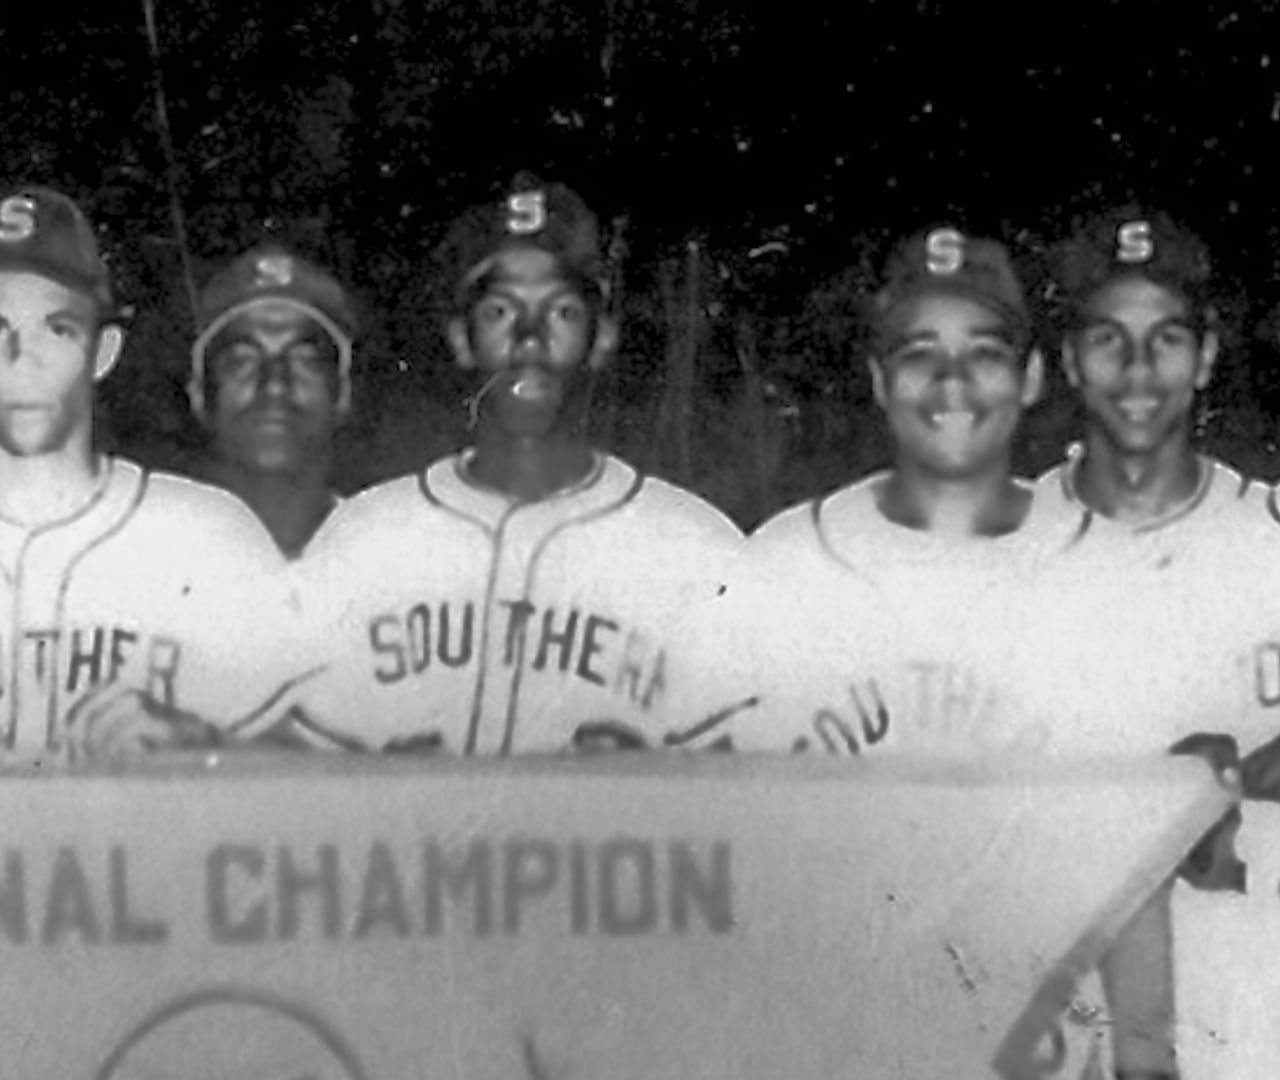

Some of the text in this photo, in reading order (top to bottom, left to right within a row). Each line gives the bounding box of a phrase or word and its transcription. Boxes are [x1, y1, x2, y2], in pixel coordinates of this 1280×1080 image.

[507, 190, 545, 233] S
[926, 227, 965, 274] S
[1117, 220, 1153, 262] S
[206, 835, 734, 945] CHAMPION
